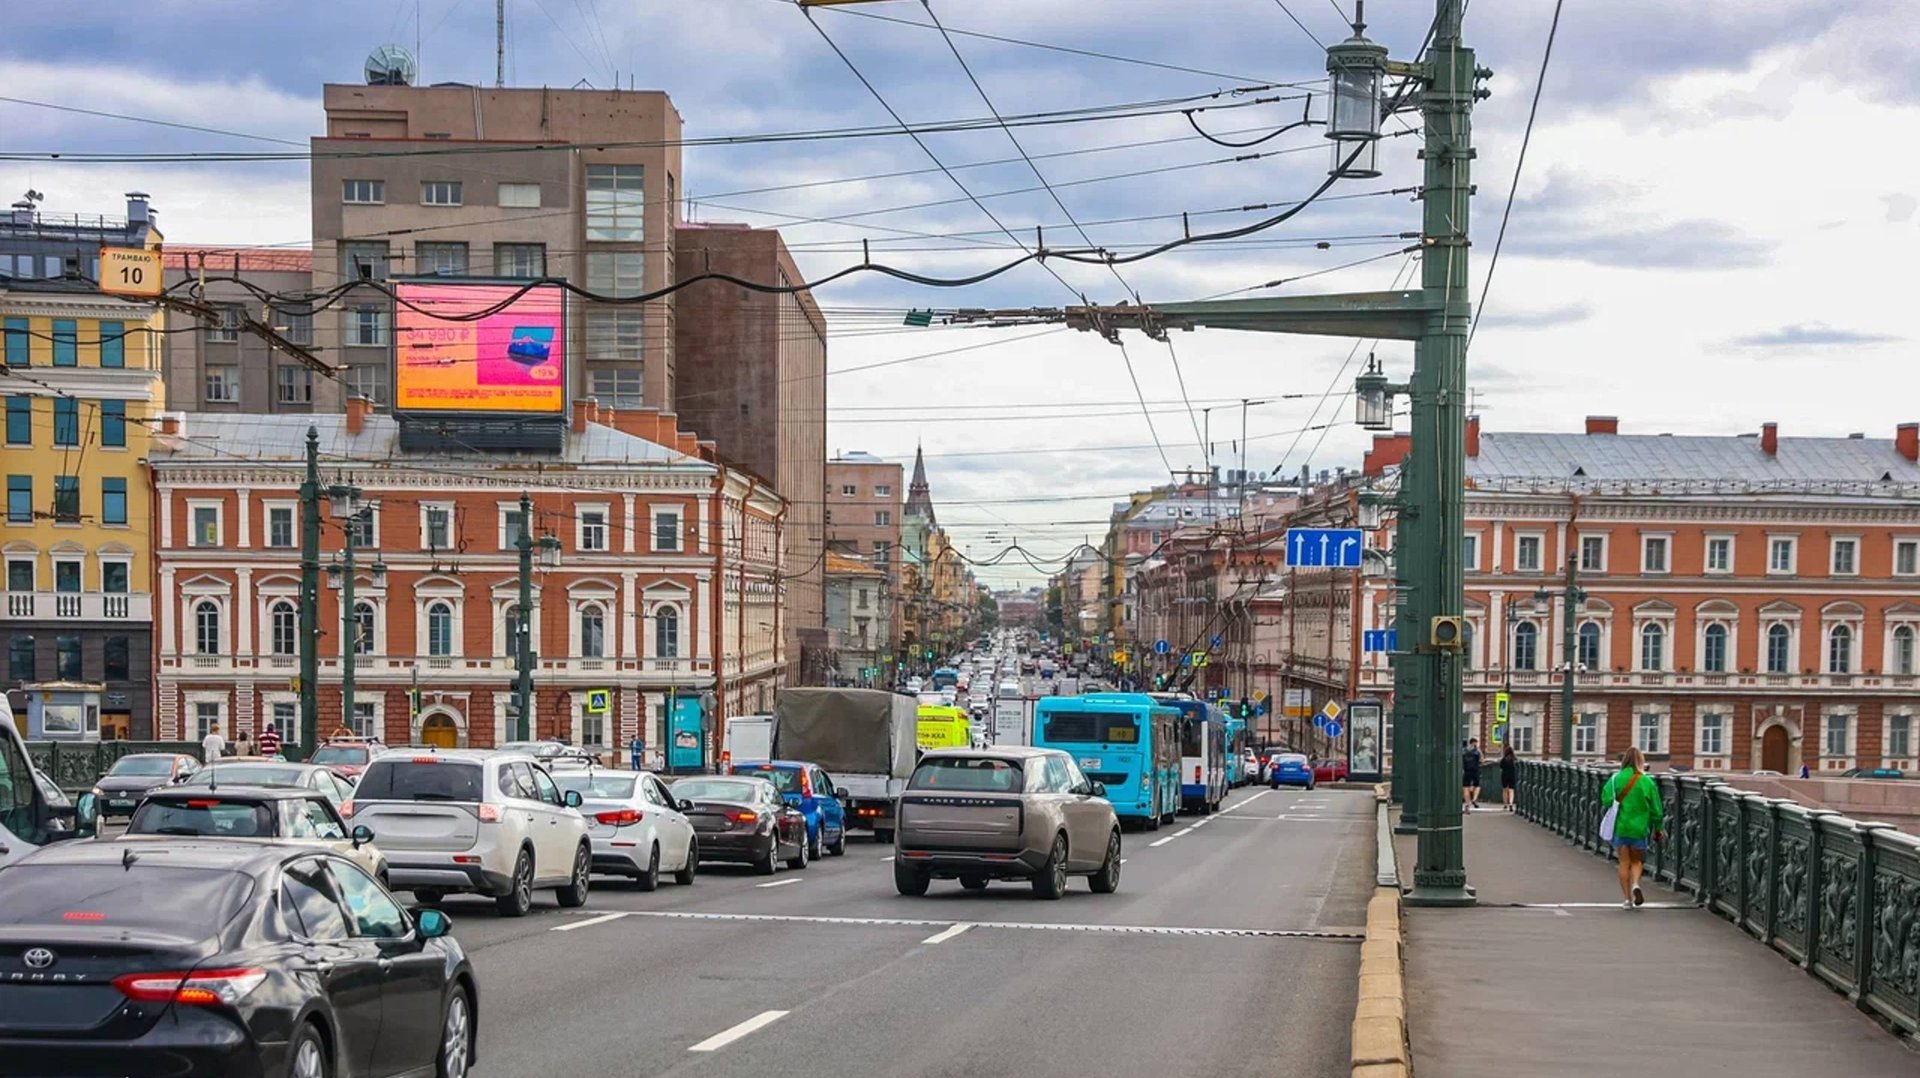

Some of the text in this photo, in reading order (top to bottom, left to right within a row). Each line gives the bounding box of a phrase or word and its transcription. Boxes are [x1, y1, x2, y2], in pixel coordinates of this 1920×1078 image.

[120, 266, 143, 285] 10
[428, 328, 456, 342] 990
[0, 971, 86, 981] AMRY
